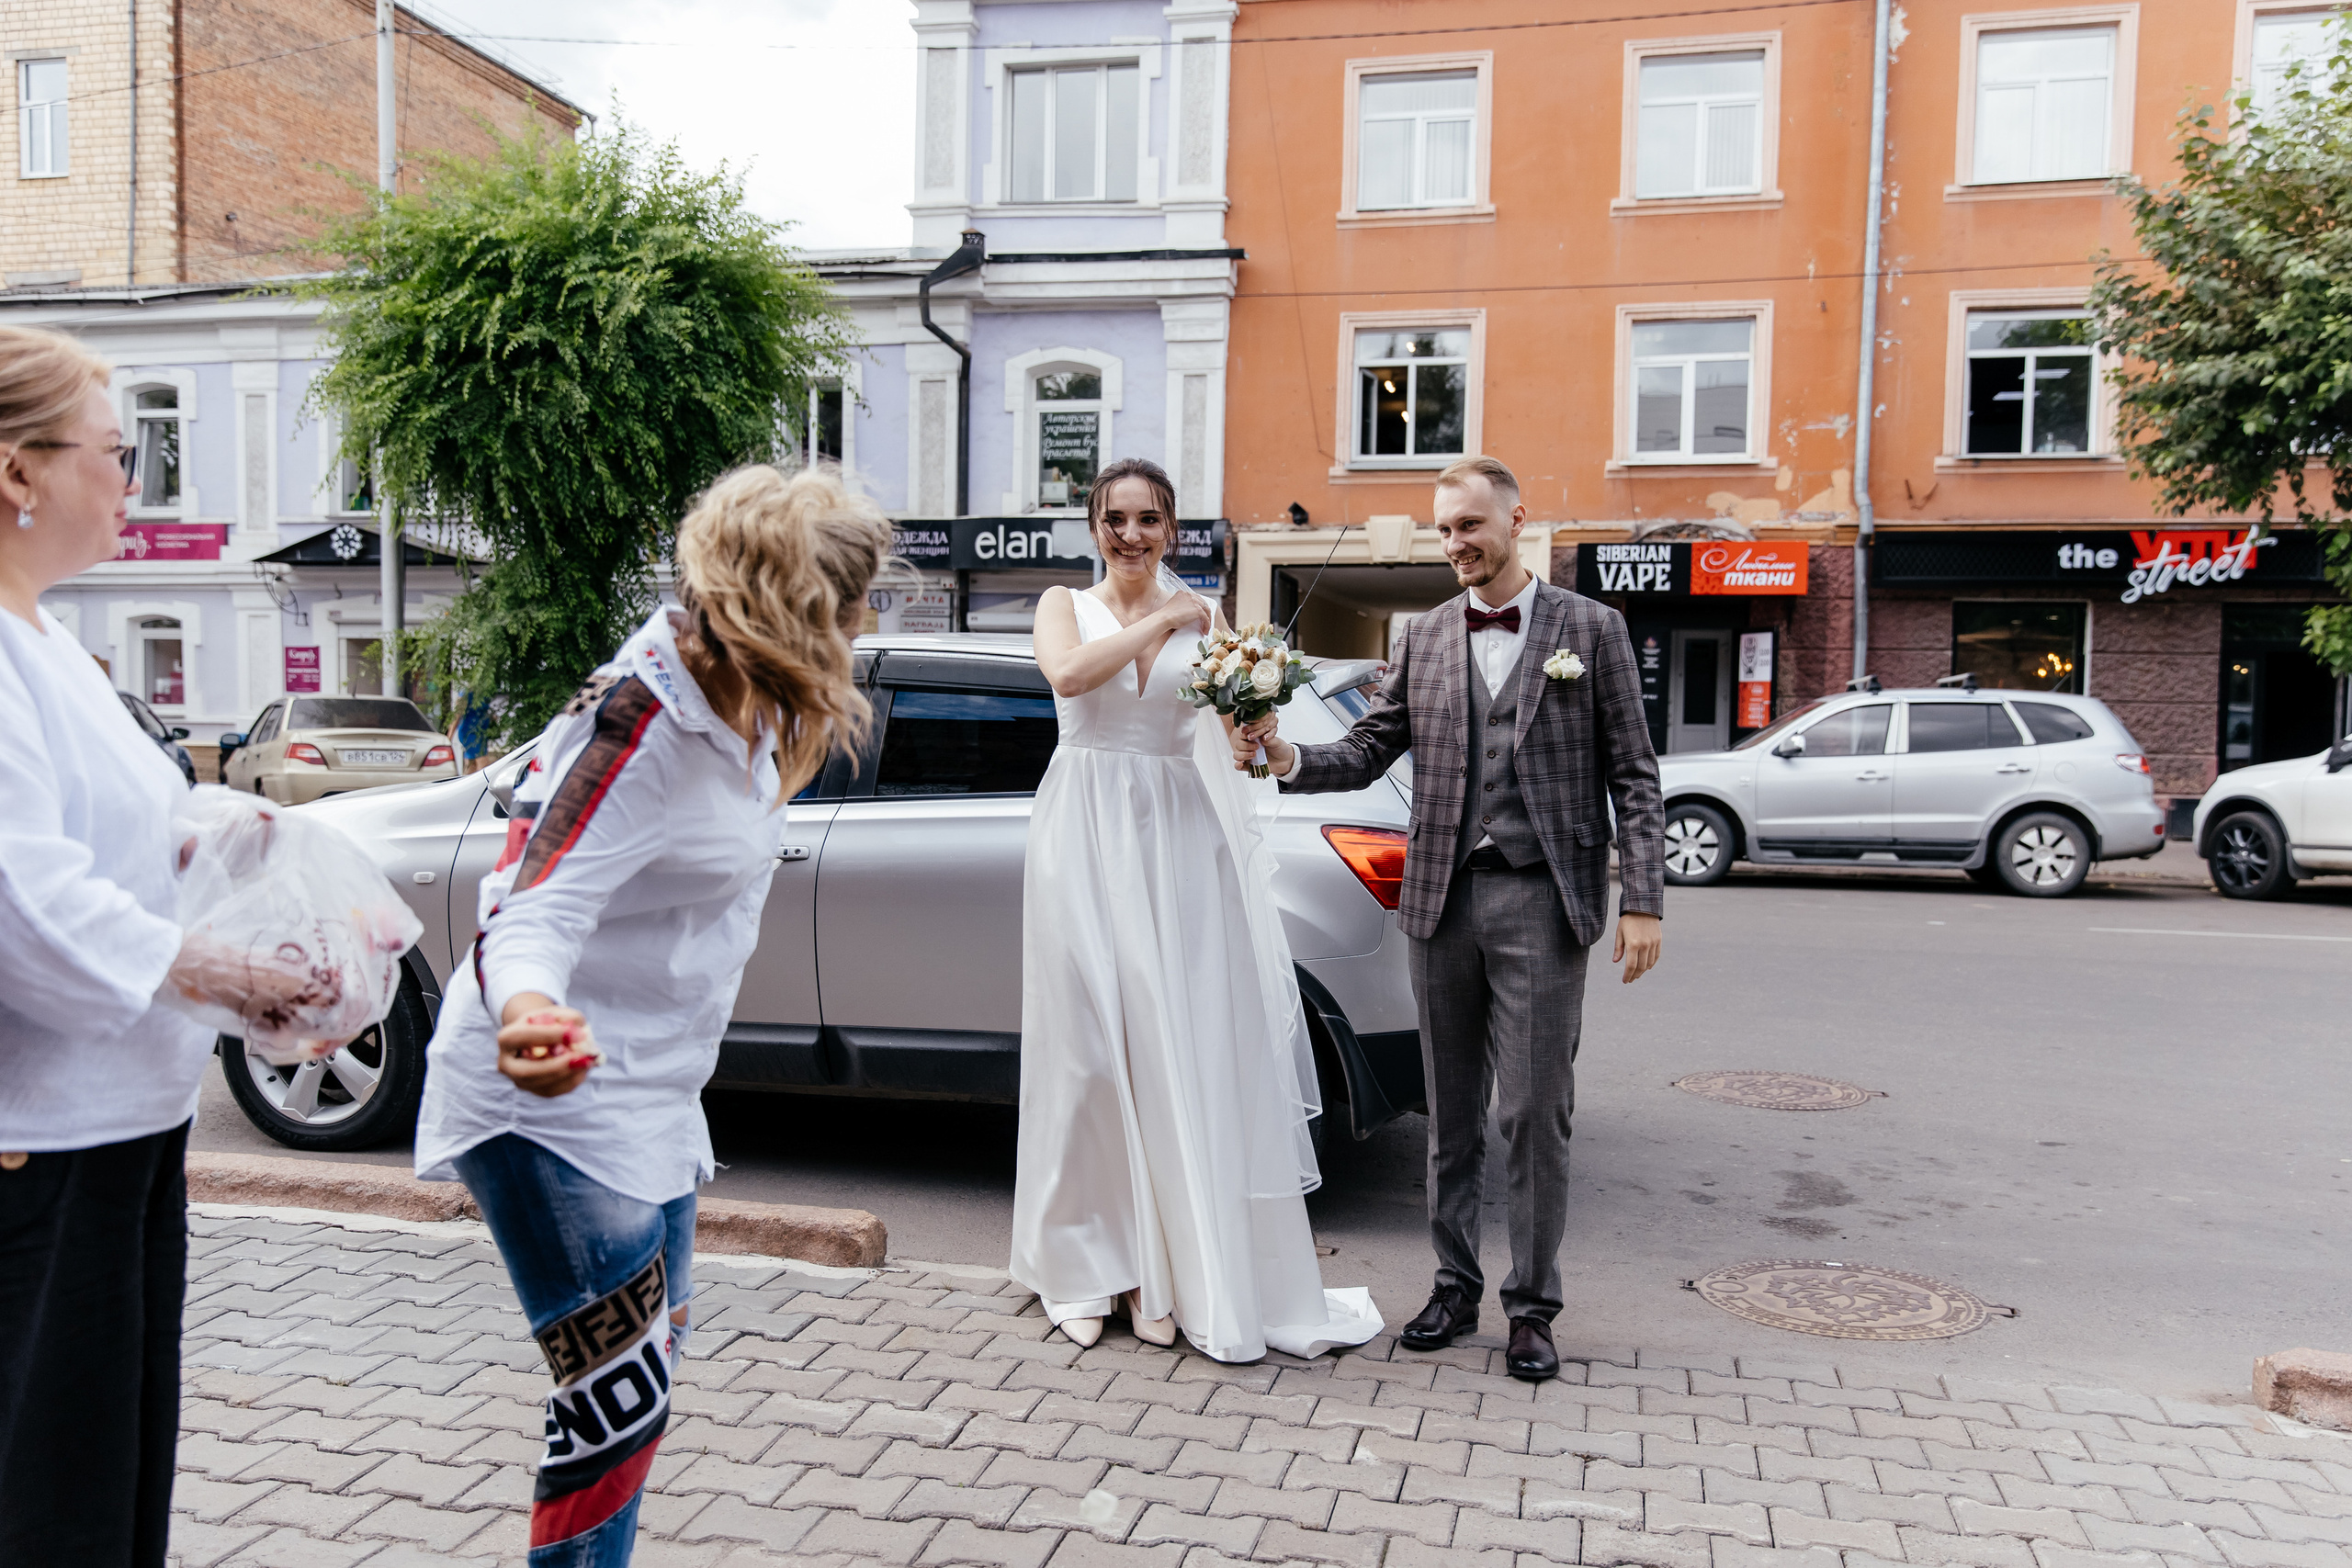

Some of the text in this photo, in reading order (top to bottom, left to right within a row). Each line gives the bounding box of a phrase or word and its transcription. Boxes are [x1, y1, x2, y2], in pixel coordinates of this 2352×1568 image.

[1044, 424, 1097, 436] украшения
[1044, 437, 1081, 448] Ремонт
[891, 531, 949, 545] ОДЕЖДА
[974, 524, 1093, 559] elan
[1177, 529, 1213, 546] ЕЖД
[909, 547, 950, 557] ЖЕНЩИН
[1596, 545, 1671, 562] SIBERIAN
[2058, 543, 2119, 570] the
[2120, 524, 2278, 604] street
[1204, 576, 1218, 586] 19
[1597, 563, 1671, 592] VAPE
[1724, 571, 1795, 586] ткани
